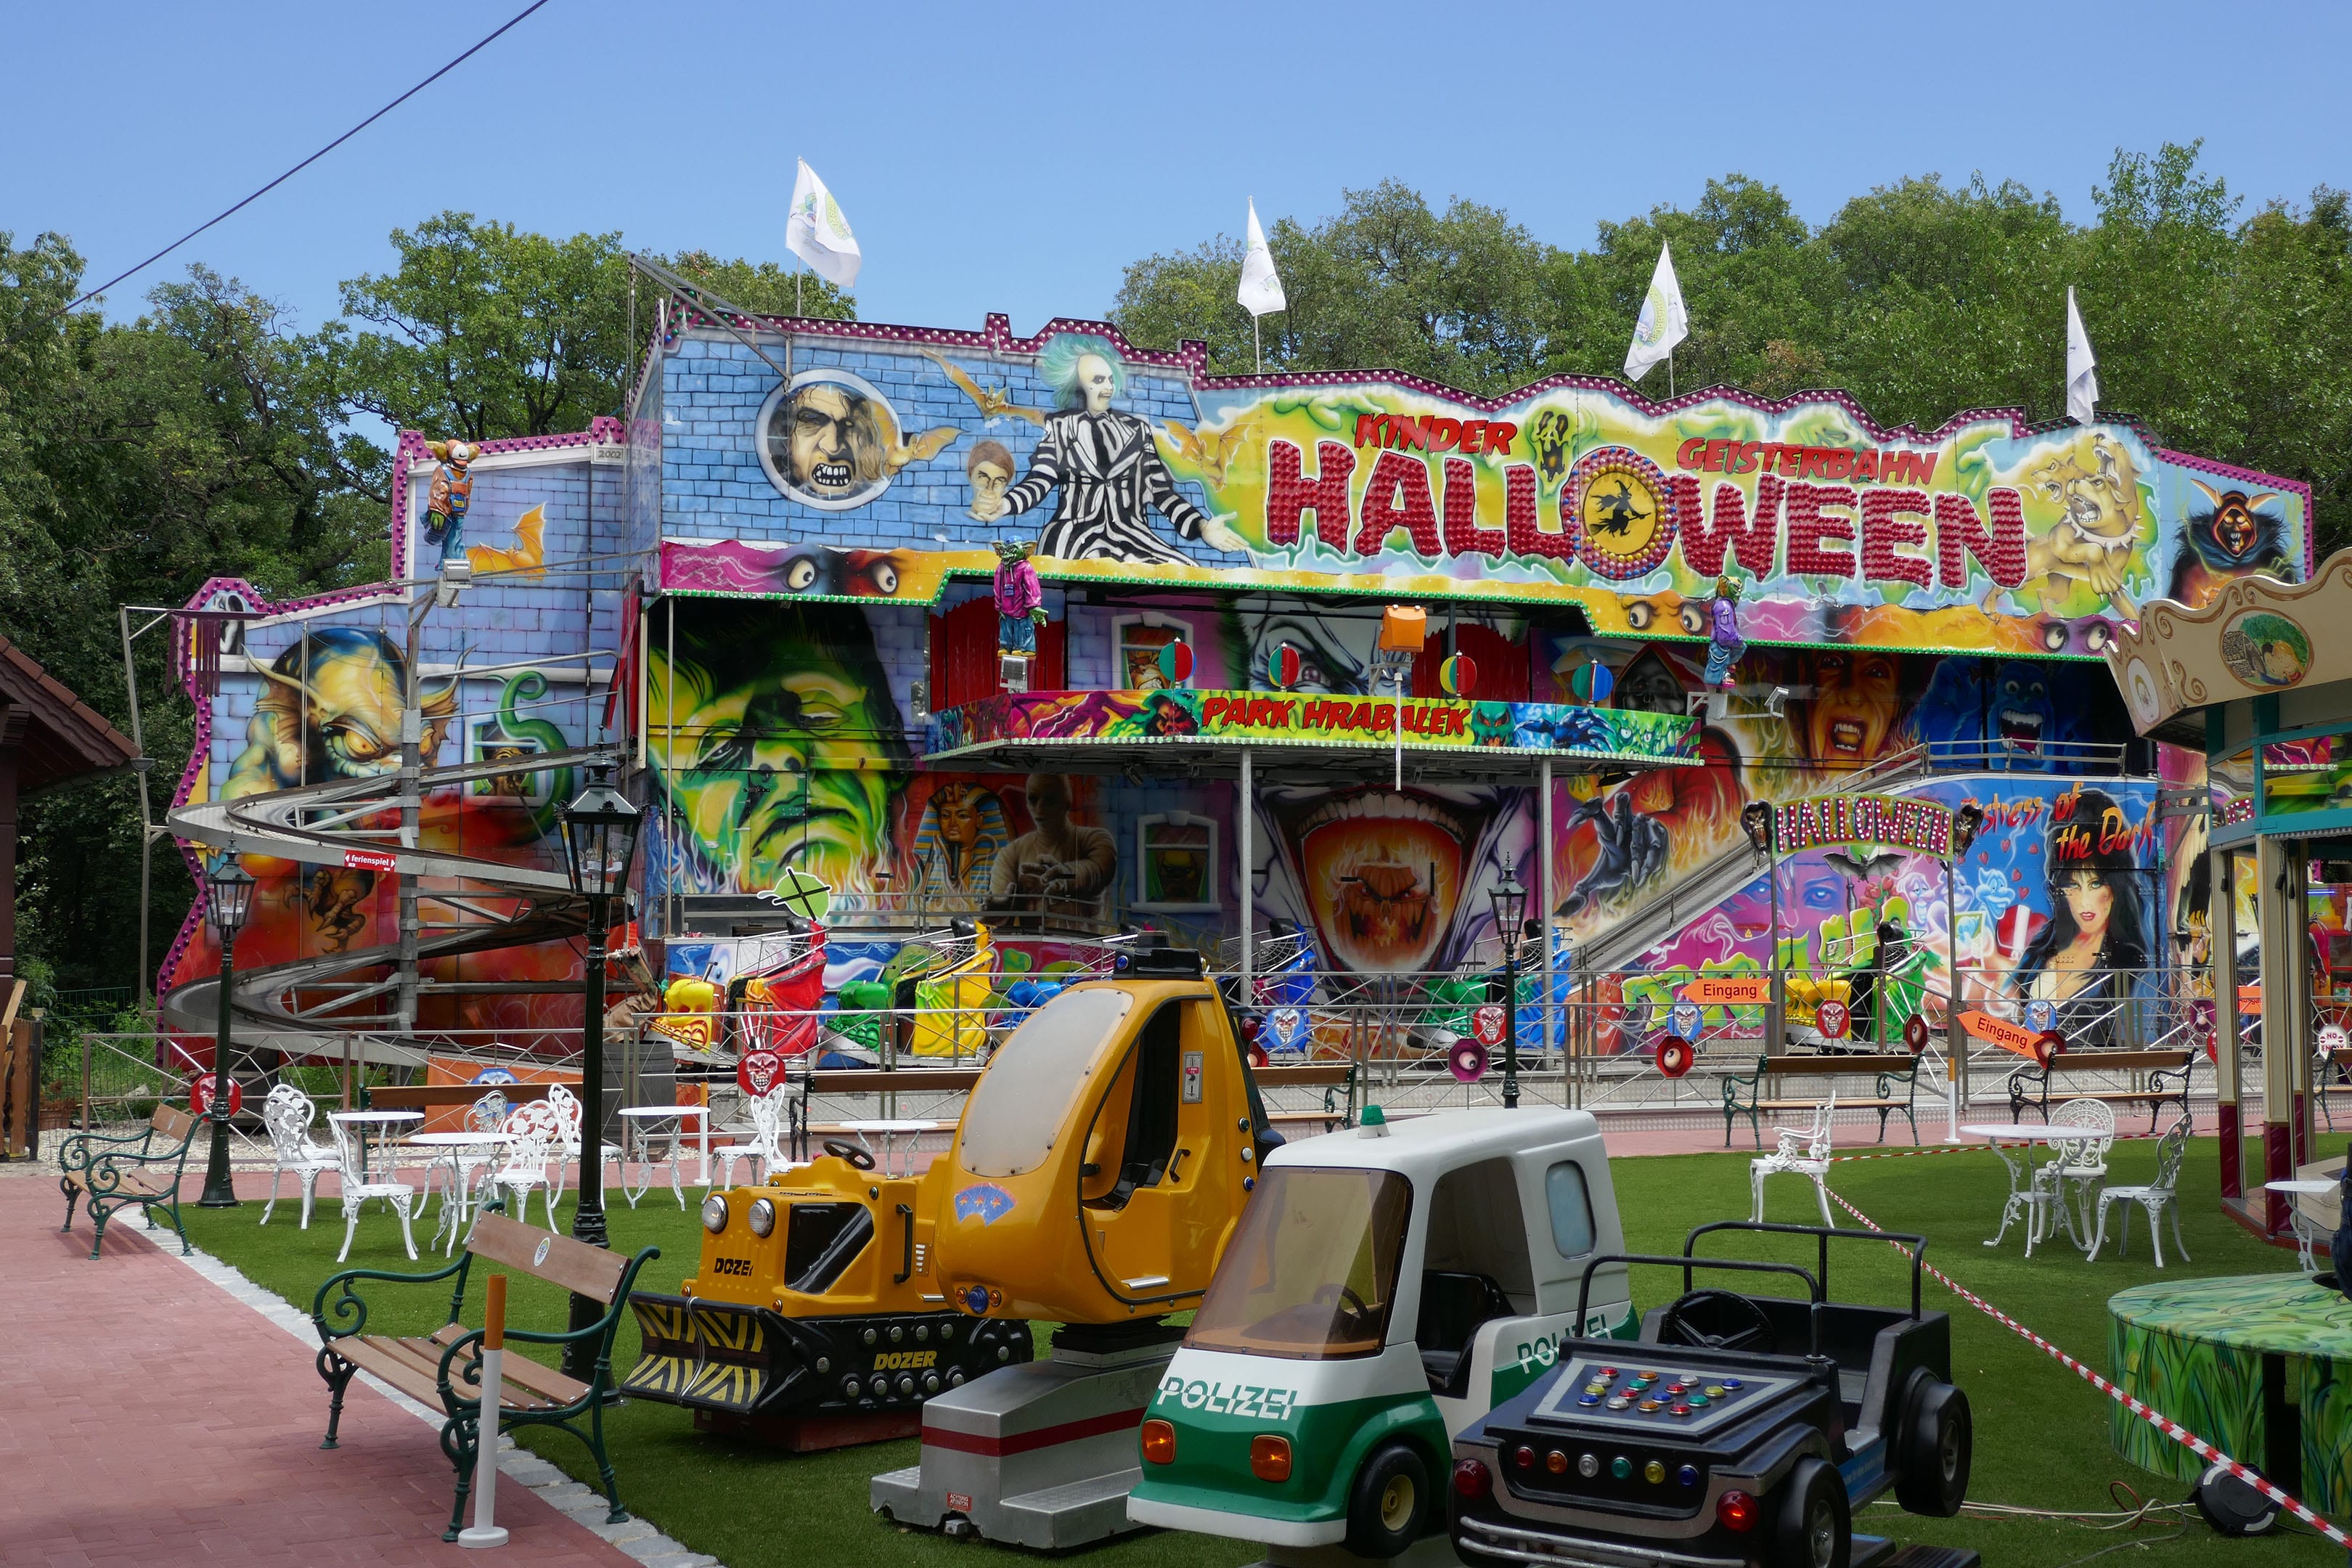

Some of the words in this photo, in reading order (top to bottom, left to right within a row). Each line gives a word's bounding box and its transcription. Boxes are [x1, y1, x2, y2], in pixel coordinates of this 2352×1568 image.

[1355, 413, 1518, 456] KINDER
[1676, 437, 1938, 486] GEISTERBAHN
[1267, 440, 2028, 592] HALLOWEEN
[1201, 697, 1296, 728] PARK
[1302, 700, 1471, 736] HRABALEK
[1776, 797, 1951, 855] HALLOWEEN
[1961, 793, 2043, 836] stress
[2054, 781, 2083, 822] of
[2055, 824, 2093, 862] the
[2099, 801, 2157, 859] Dark
[351, 854, 389, 866] ferienspiel
[1703, 984, 1757, 999] Eingang
[1977, 1017, 2028, 1049] Eingang
[873, 1350, 937, 1371] DOZER
[1516, 1314, 1612, 1375] POLEI
[1156, 1376, 1298, 1421] POLIZEI
